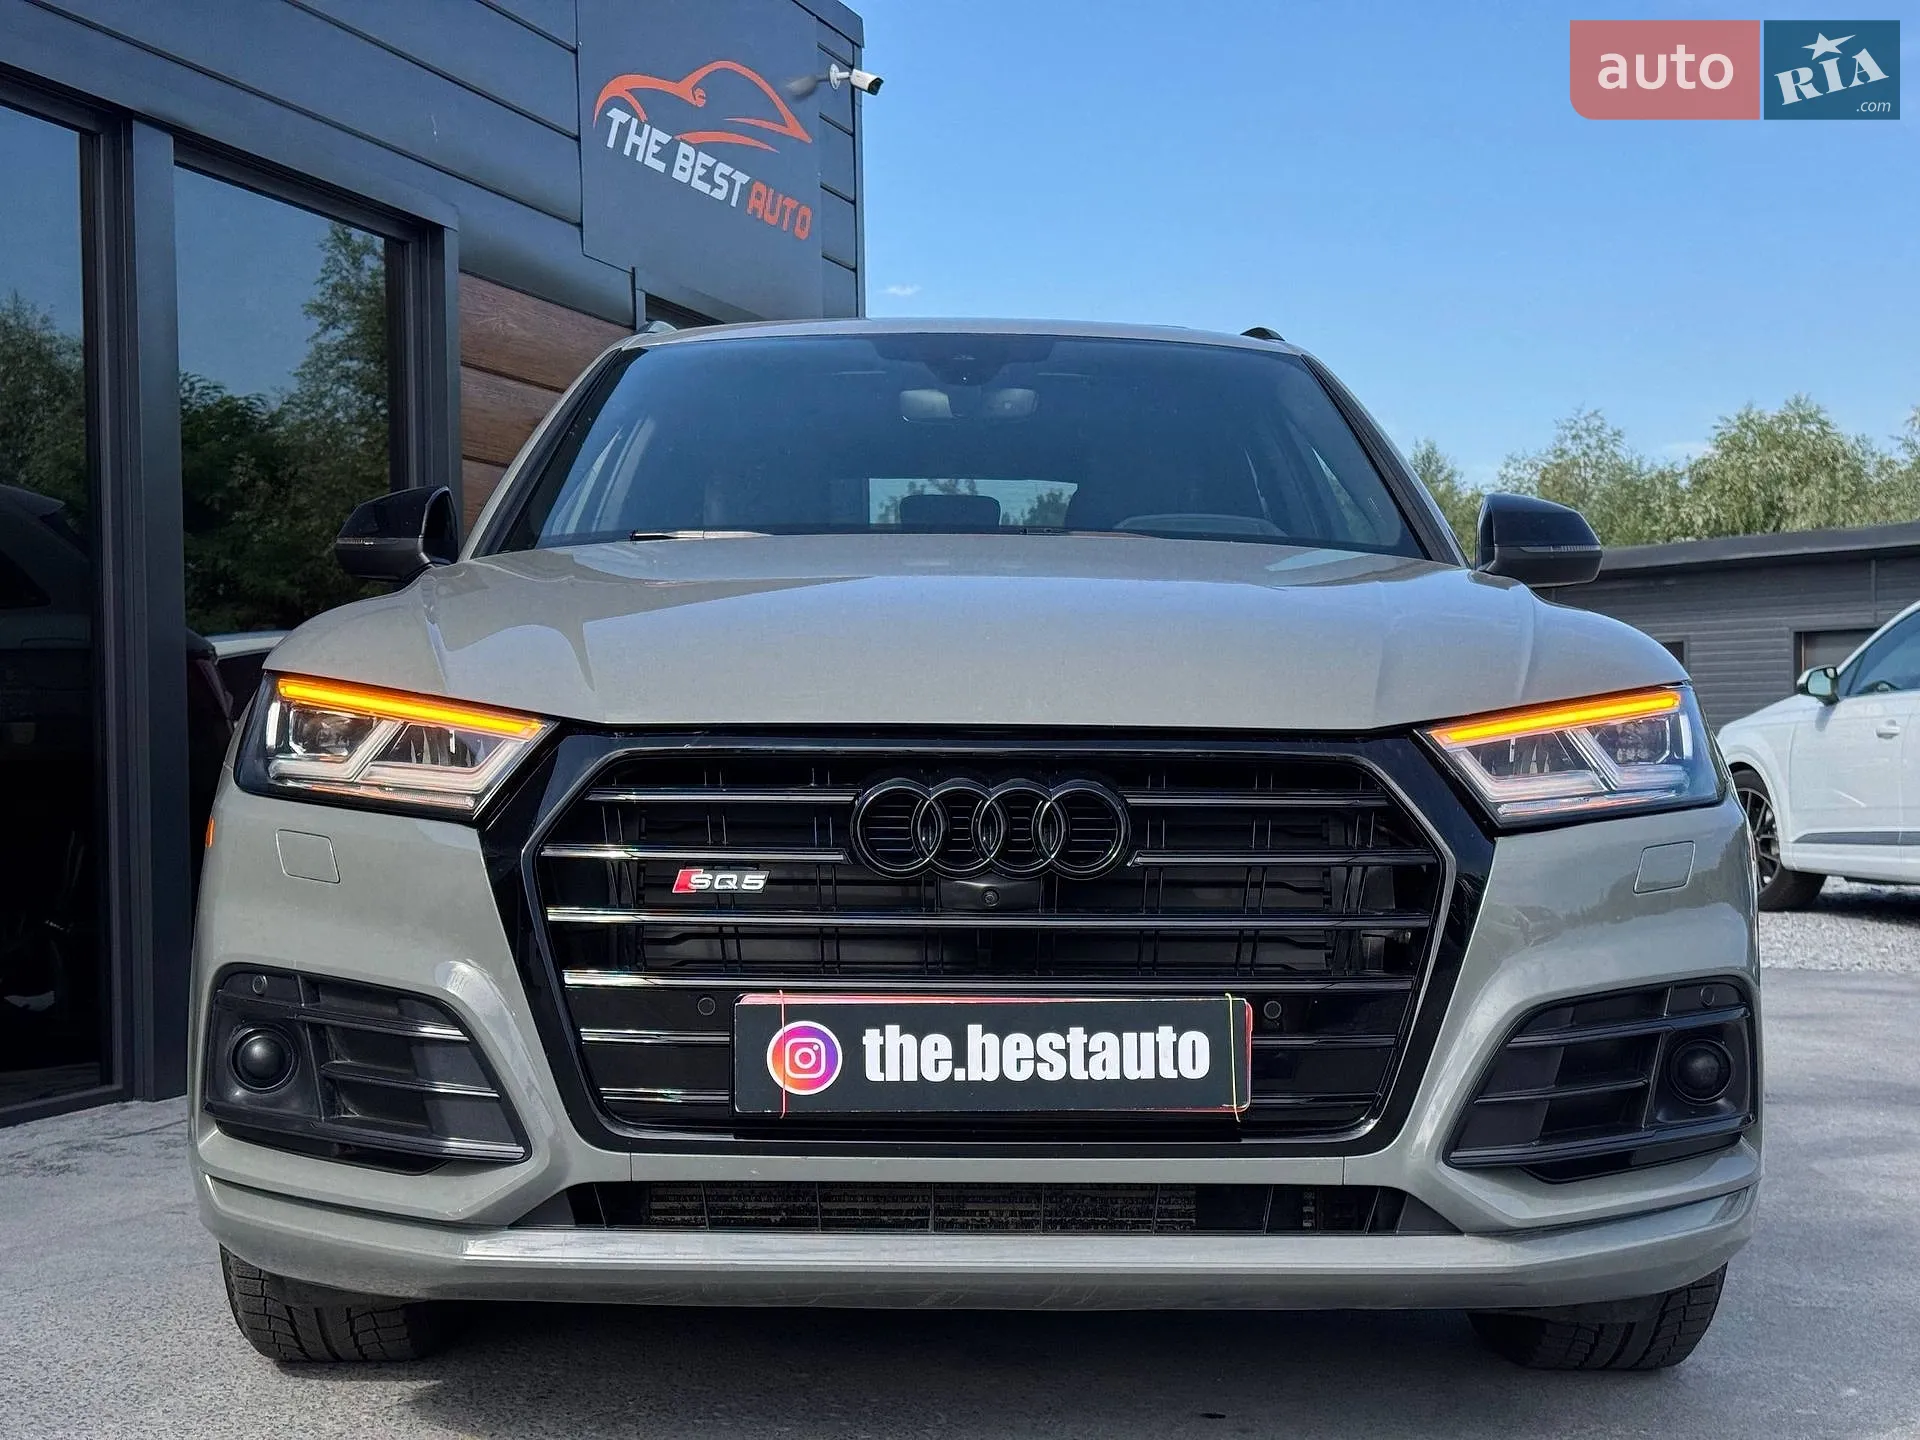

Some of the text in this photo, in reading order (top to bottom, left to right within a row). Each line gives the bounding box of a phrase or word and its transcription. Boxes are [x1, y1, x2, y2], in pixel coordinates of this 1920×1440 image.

[606, 107, 812, 240] THE BEST AUTO
[688, 873, 766, 890] SQ5
[862, 1024, 1211, 1082] the.bestauto
